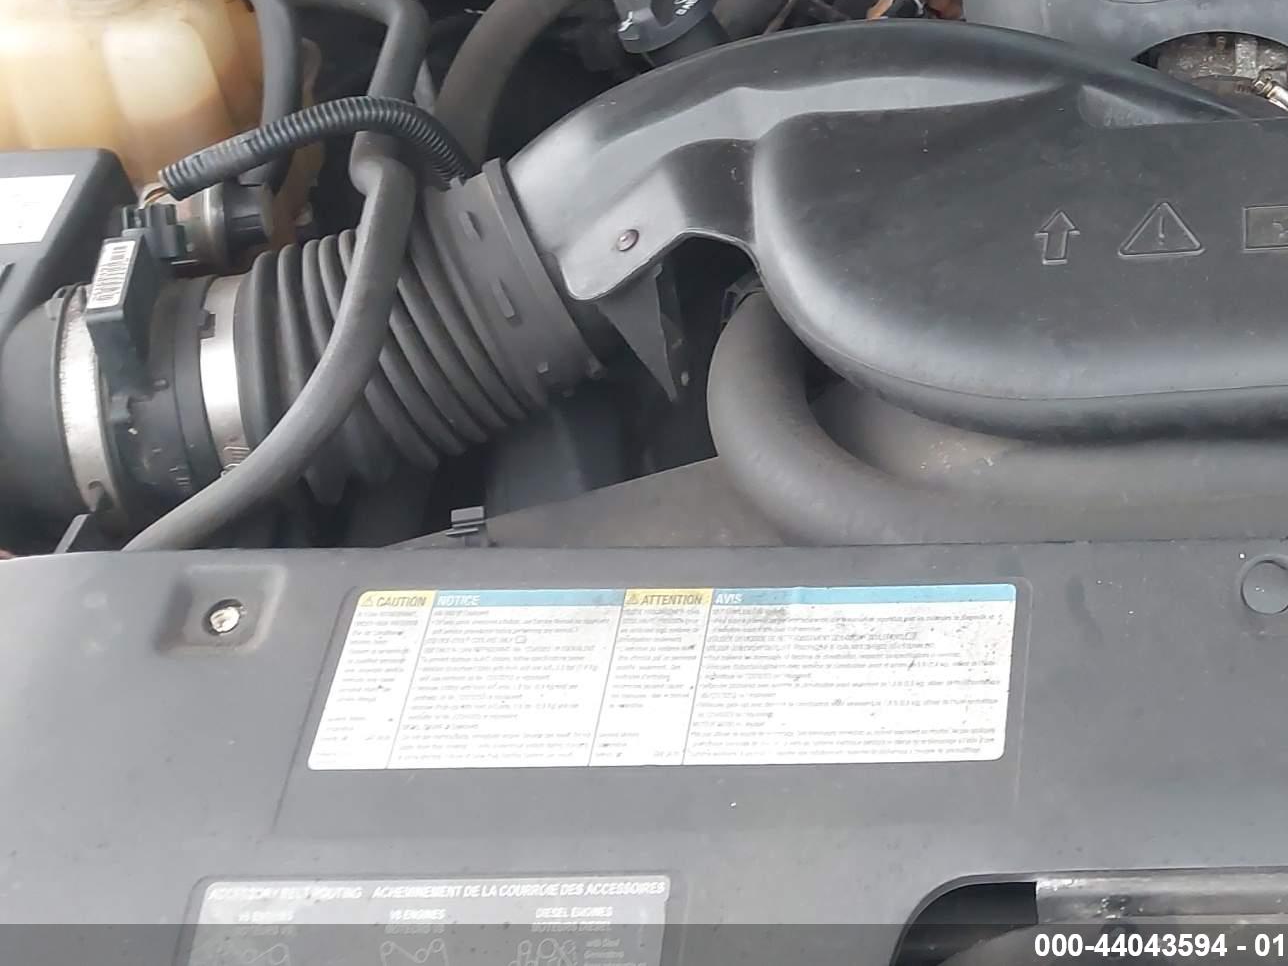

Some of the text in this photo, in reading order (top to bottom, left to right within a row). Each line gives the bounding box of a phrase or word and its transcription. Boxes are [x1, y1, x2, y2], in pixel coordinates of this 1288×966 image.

[376, 596, 427, 607] CAUTION
[436, 595, 481, 607] NOTICE
[640, 594, 703, 605] ATTENTION
[715, 594, 744, 604] AVIS
[463, 884, 480, 898] DE
[481, 884, 497, 897] LA
[560, 882, 583, 896] DES
[584, 882, 666, 896] ACCESSOIRES
